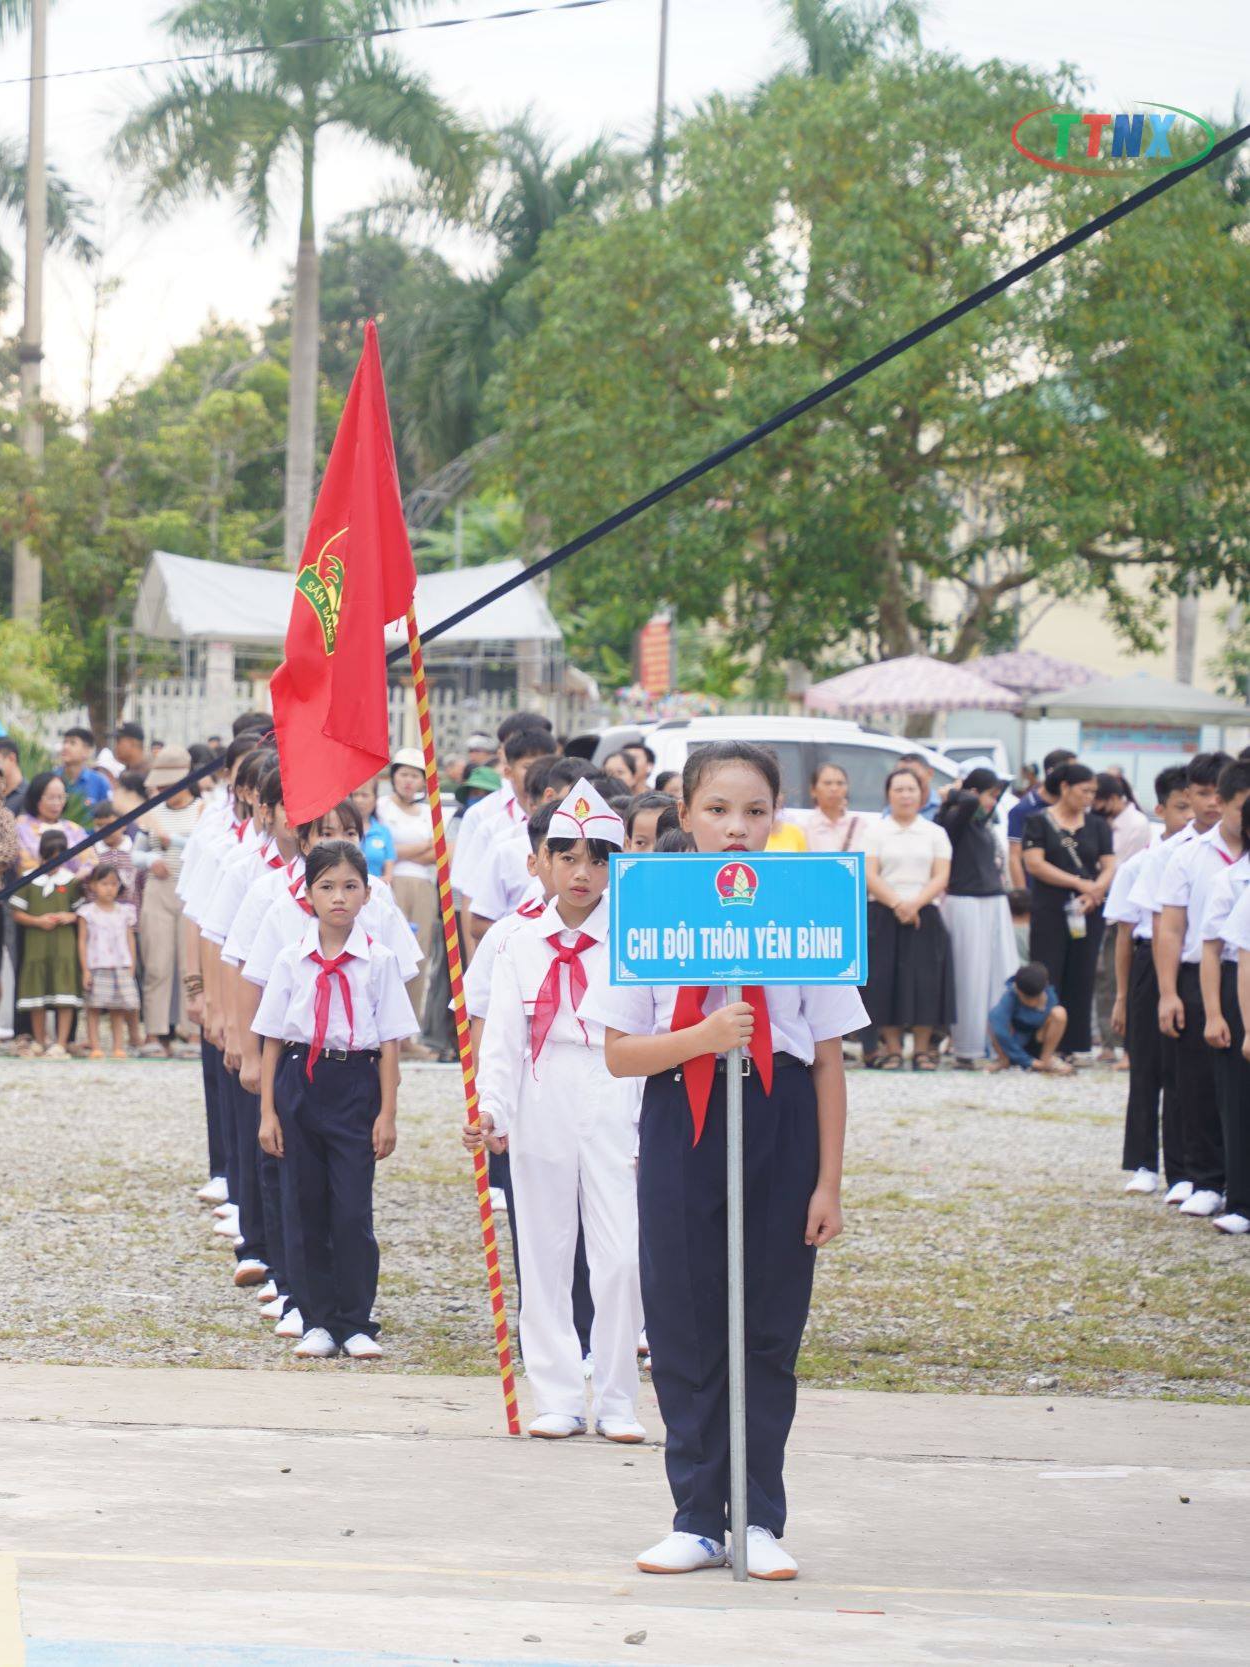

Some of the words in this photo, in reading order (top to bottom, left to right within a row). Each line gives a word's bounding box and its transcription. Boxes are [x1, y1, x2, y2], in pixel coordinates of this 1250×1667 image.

[626, 927, 658, 961] CHI
[663, 920, 695, 967] ĐỘI
[699, 920, 750, 960] THÔN
[754, 920, 792, 959] YÊN
[797, 920, 843, 959] BÌNH
